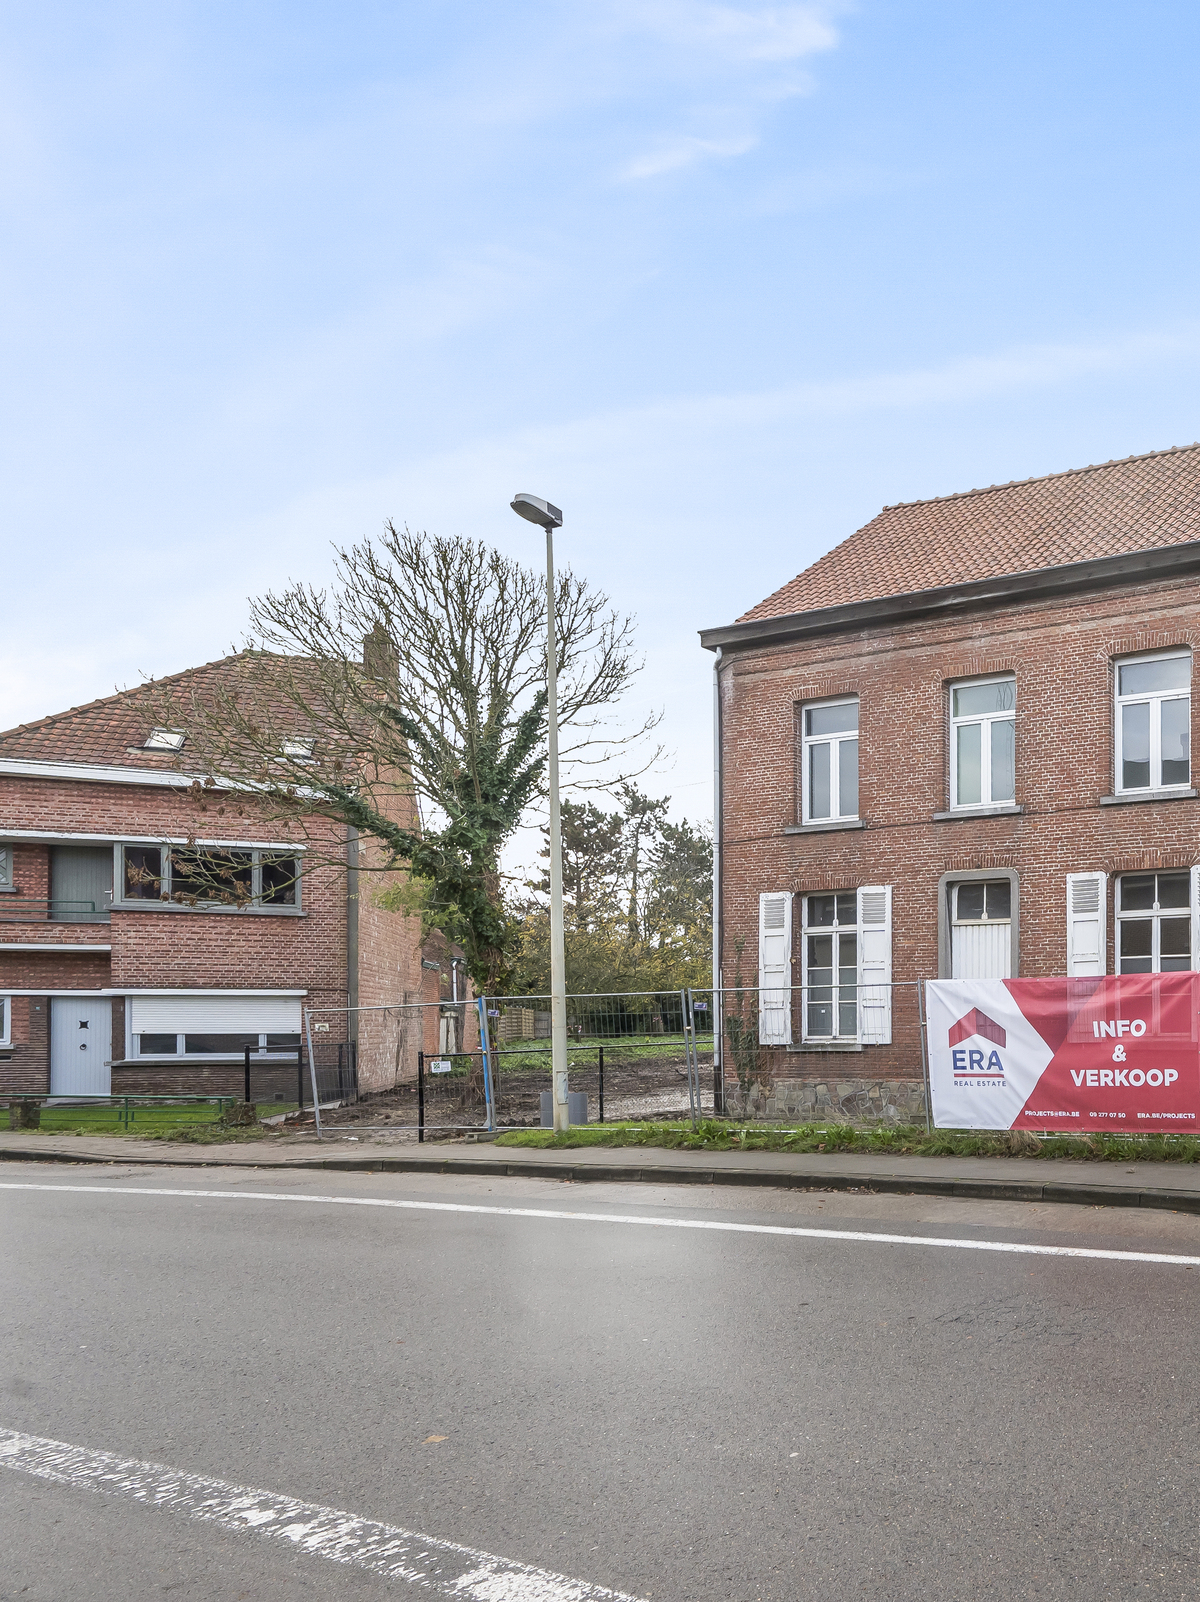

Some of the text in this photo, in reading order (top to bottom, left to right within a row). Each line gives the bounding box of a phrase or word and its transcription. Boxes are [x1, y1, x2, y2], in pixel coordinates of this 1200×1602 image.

[1092, 1019, 1147, 1038] INFO
[952, 1050, 1004, 1071] ERA
[1112, 1044, 1127, 1062] &
[1070, 1068, 1179, 1087] VERKOOP
